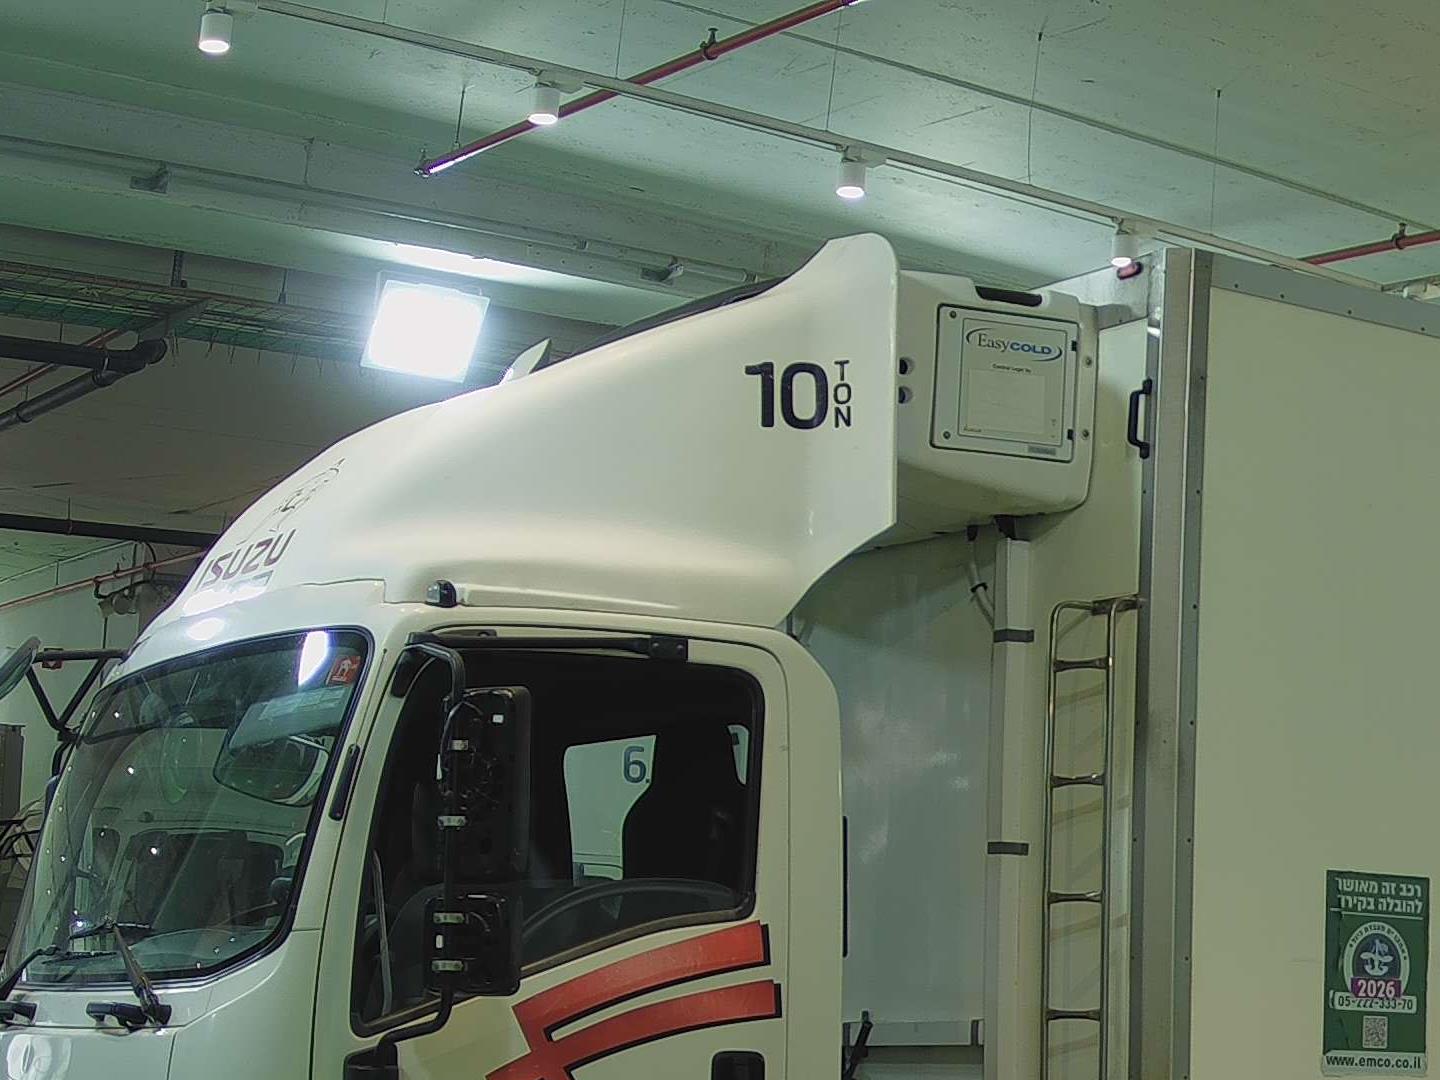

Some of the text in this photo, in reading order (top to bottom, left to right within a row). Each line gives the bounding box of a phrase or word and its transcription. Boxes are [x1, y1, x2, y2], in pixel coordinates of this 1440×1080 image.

[745, 360, 852, 429] 10 TON
[194, 529, 297, 591] ISUZU
[1335, 877, 1422, 897] רכב זה מאושר
[1377, 897, 1423, 914] להובלה
[1357, 979, 1396, 998] 2026
[1325, 1055, 1422, 1069] www.emco.co.il
